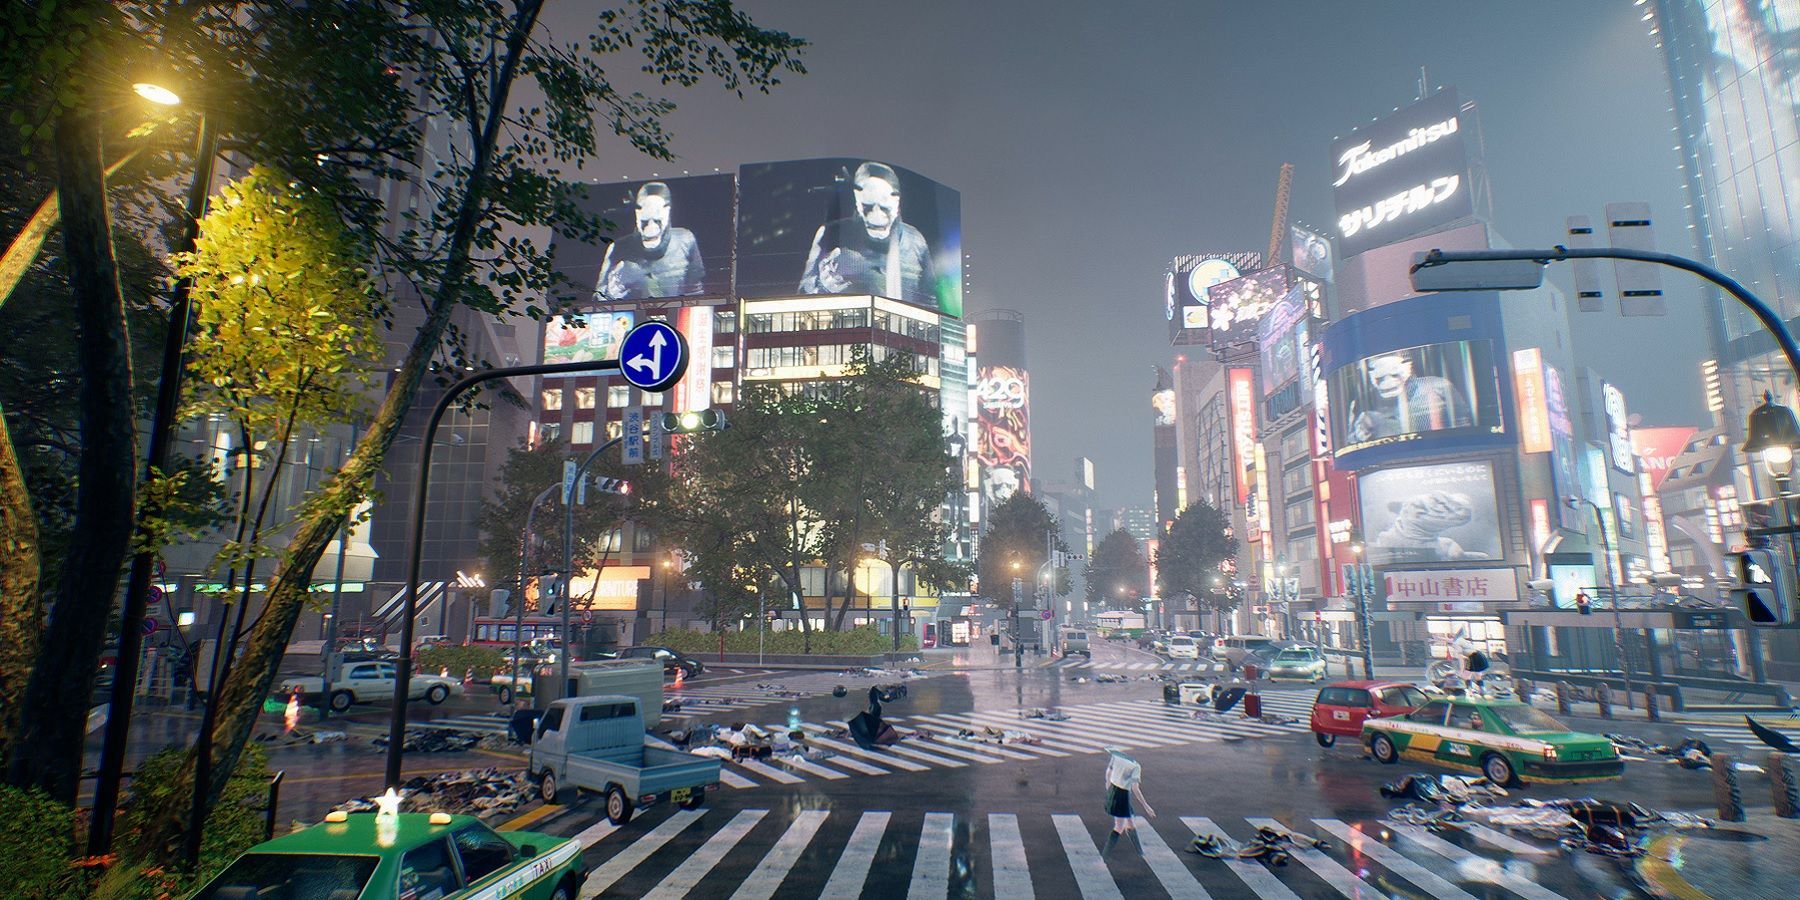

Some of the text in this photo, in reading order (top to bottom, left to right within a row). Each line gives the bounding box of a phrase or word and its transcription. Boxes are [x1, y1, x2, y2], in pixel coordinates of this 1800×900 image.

[629, 412, 639, 458] 渋谷駅前
[1397, 577, 1488, 597] 中山書店
[533, 857, 552, 878] TAXI
